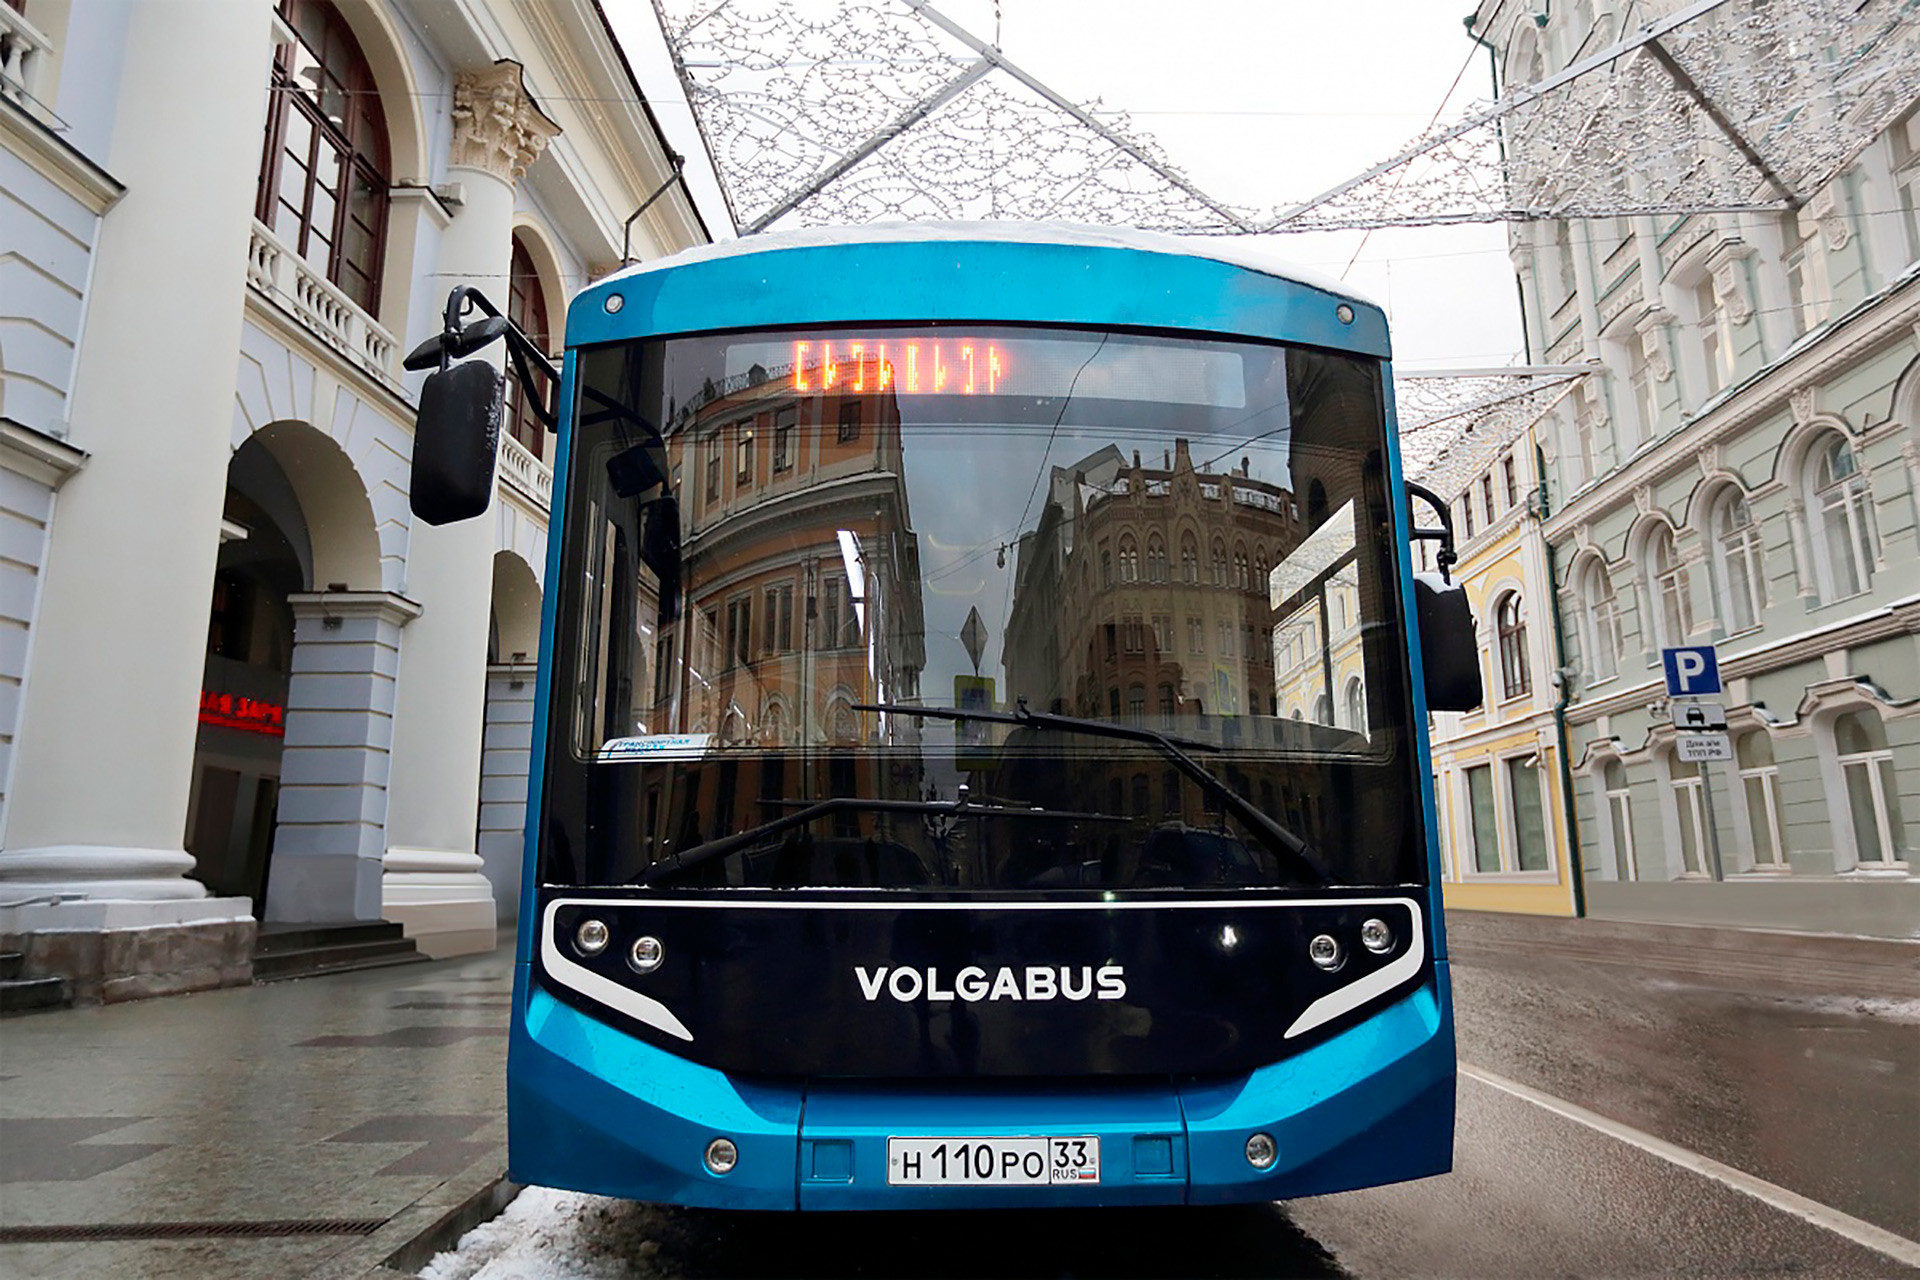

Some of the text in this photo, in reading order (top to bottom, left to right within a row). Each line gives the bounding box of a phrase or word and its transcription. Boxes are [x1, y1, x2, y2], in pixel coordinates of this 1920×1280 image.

[1675, 651, 1705, 691] P
[854, 966, 1127, 1001] VOLGABUS
[1054, 1141, 1087, 1168] 33
[1053, 1169, 1077, 1180] RUS
